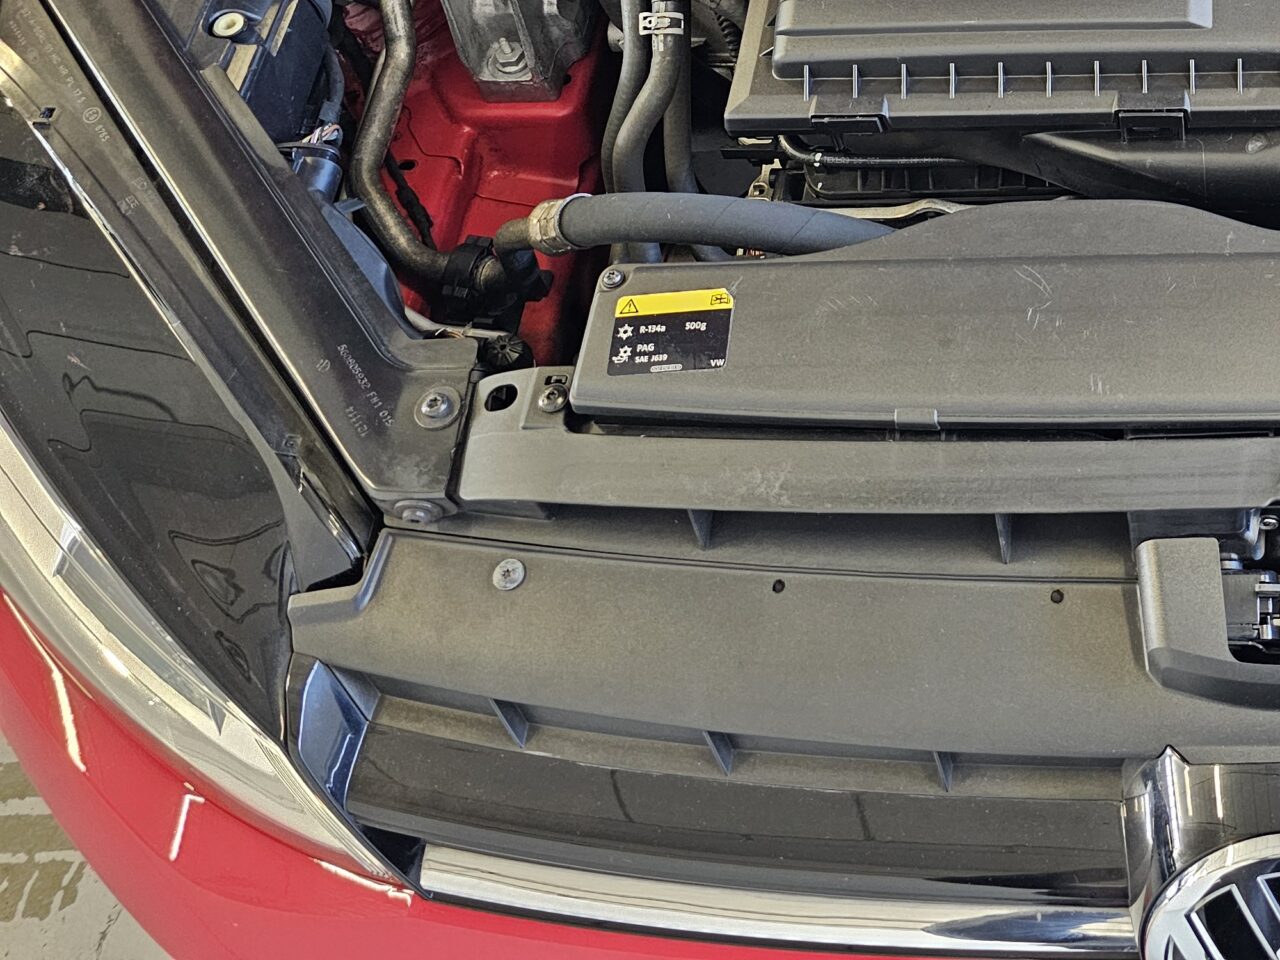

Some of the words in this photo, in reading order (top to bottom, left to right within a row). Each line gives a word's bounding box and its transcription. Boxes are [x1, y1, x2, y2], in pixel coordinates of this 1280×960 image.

[639, 324, 667, 334] R-134a
[685, 321, 707, 331] 500g
[636, 343, 655, 353] PAG
[635, 355, 649, 363] SAE
[650, 354, 668, 362] J639
[709, 359, 725, 367] VW
